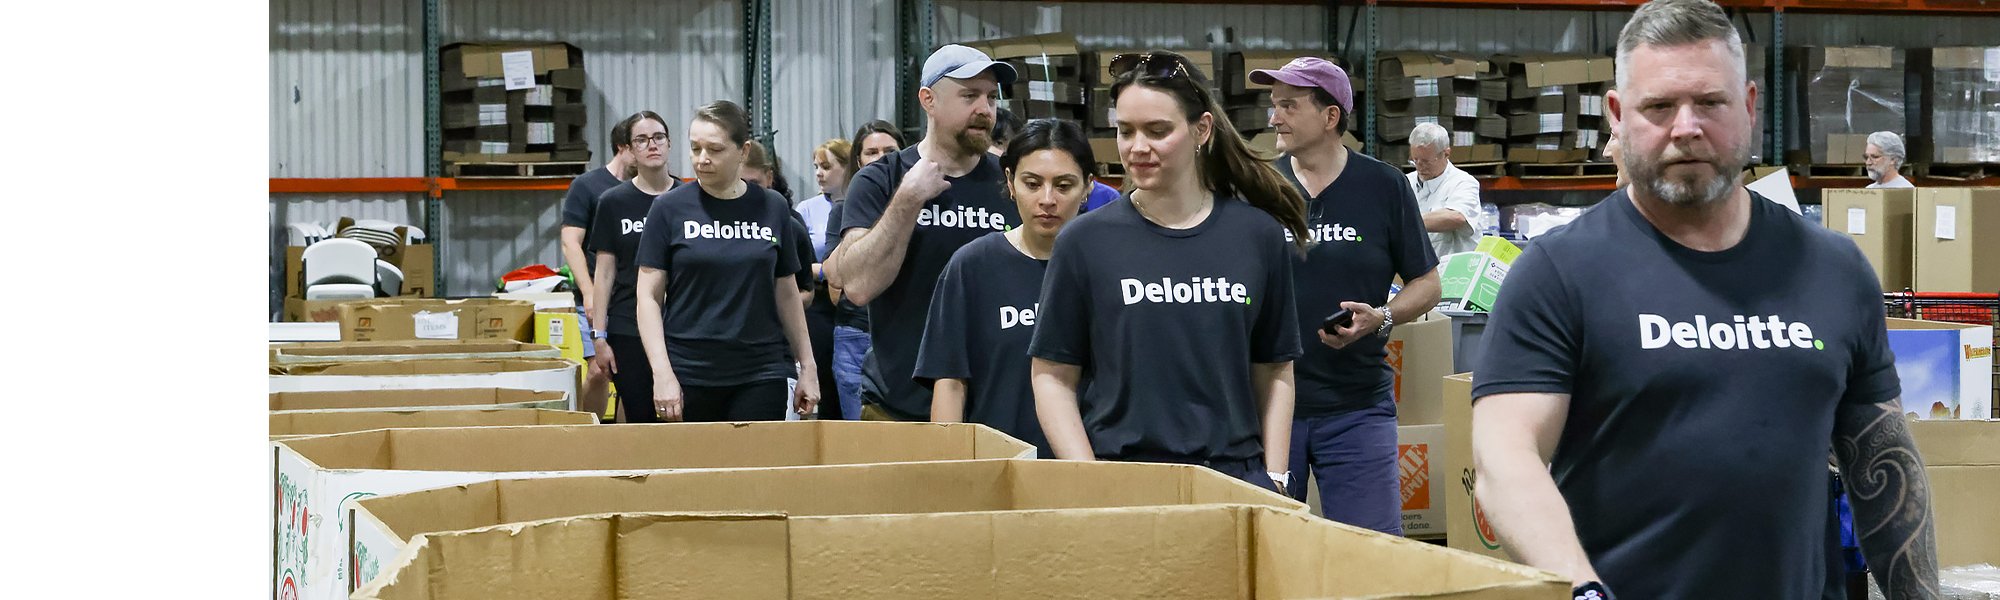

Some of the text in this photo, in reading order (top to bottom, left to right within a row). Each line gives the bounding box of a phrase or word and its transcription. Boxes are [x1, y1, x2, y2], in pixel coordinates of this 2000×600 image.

[683, 220, 777, 243] Deloitte.
[916, 204, 1012, 232] eloitte.
[1120, 276, 1251, 306] Deloitte.
[1638, 313, 1825, 350] Deloitte.
